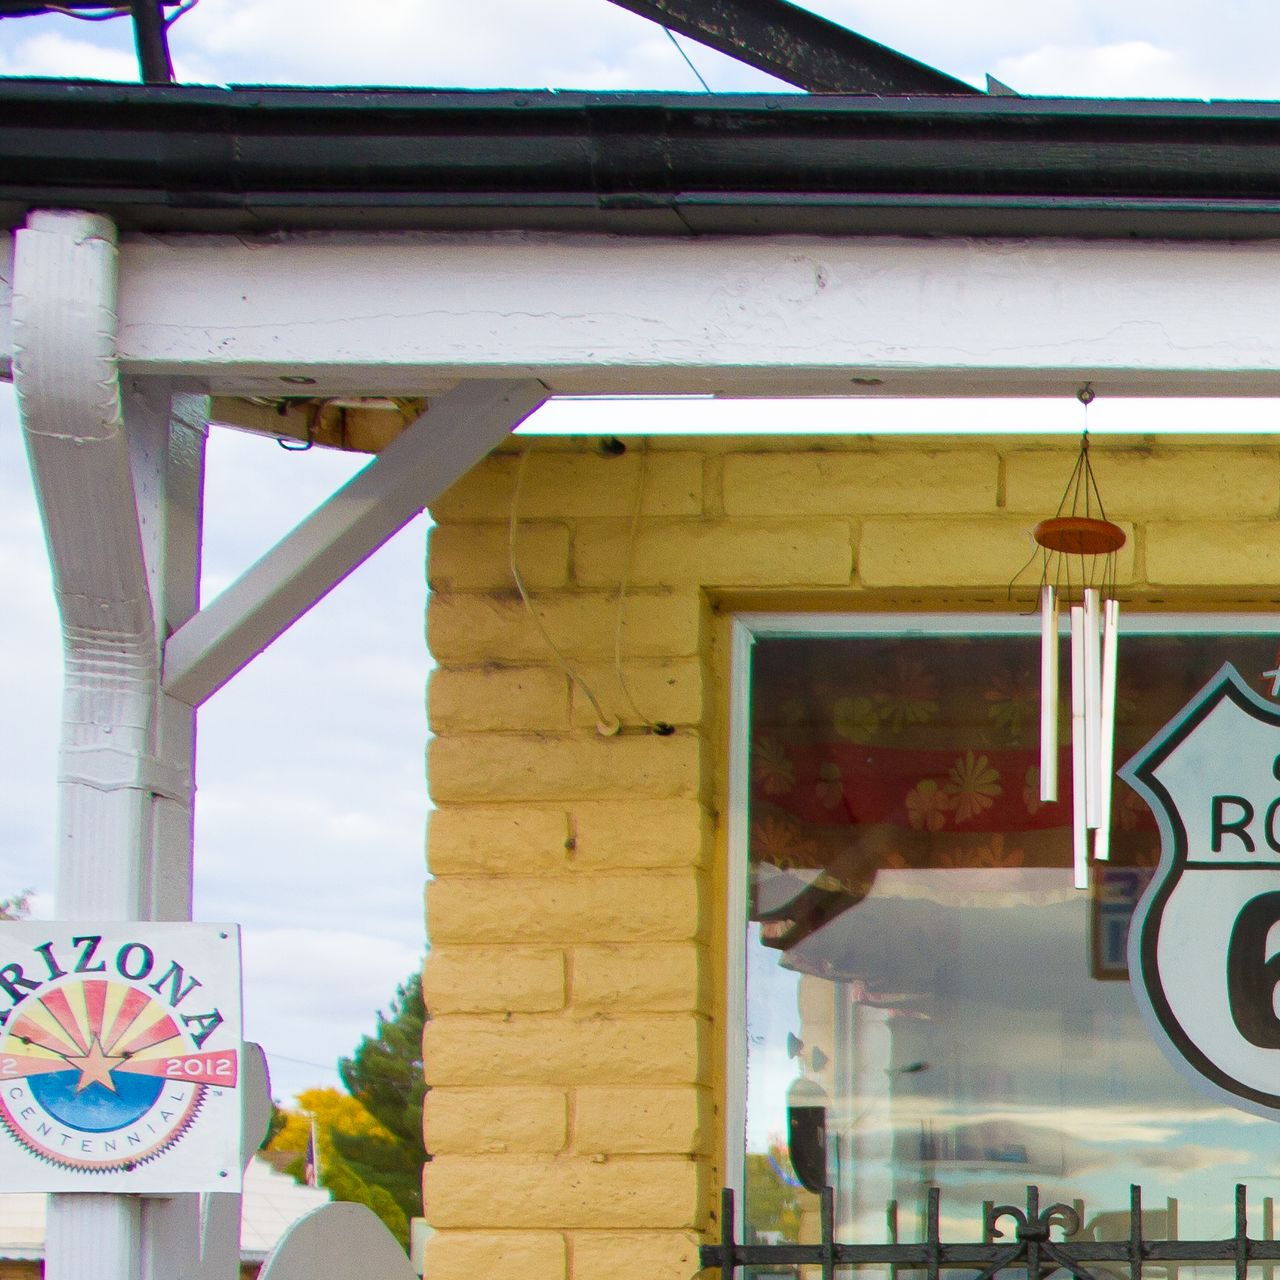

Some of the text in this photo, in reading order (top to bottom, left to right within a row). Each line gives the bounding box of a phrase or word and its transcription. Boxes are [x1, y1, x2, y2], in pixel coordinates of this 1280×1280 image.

[0, 935, 224, 1050] RIZONA
[166, 1059, 232, 1076] 2012
[9, 1087, 185, 1153] CENTENNIAL
